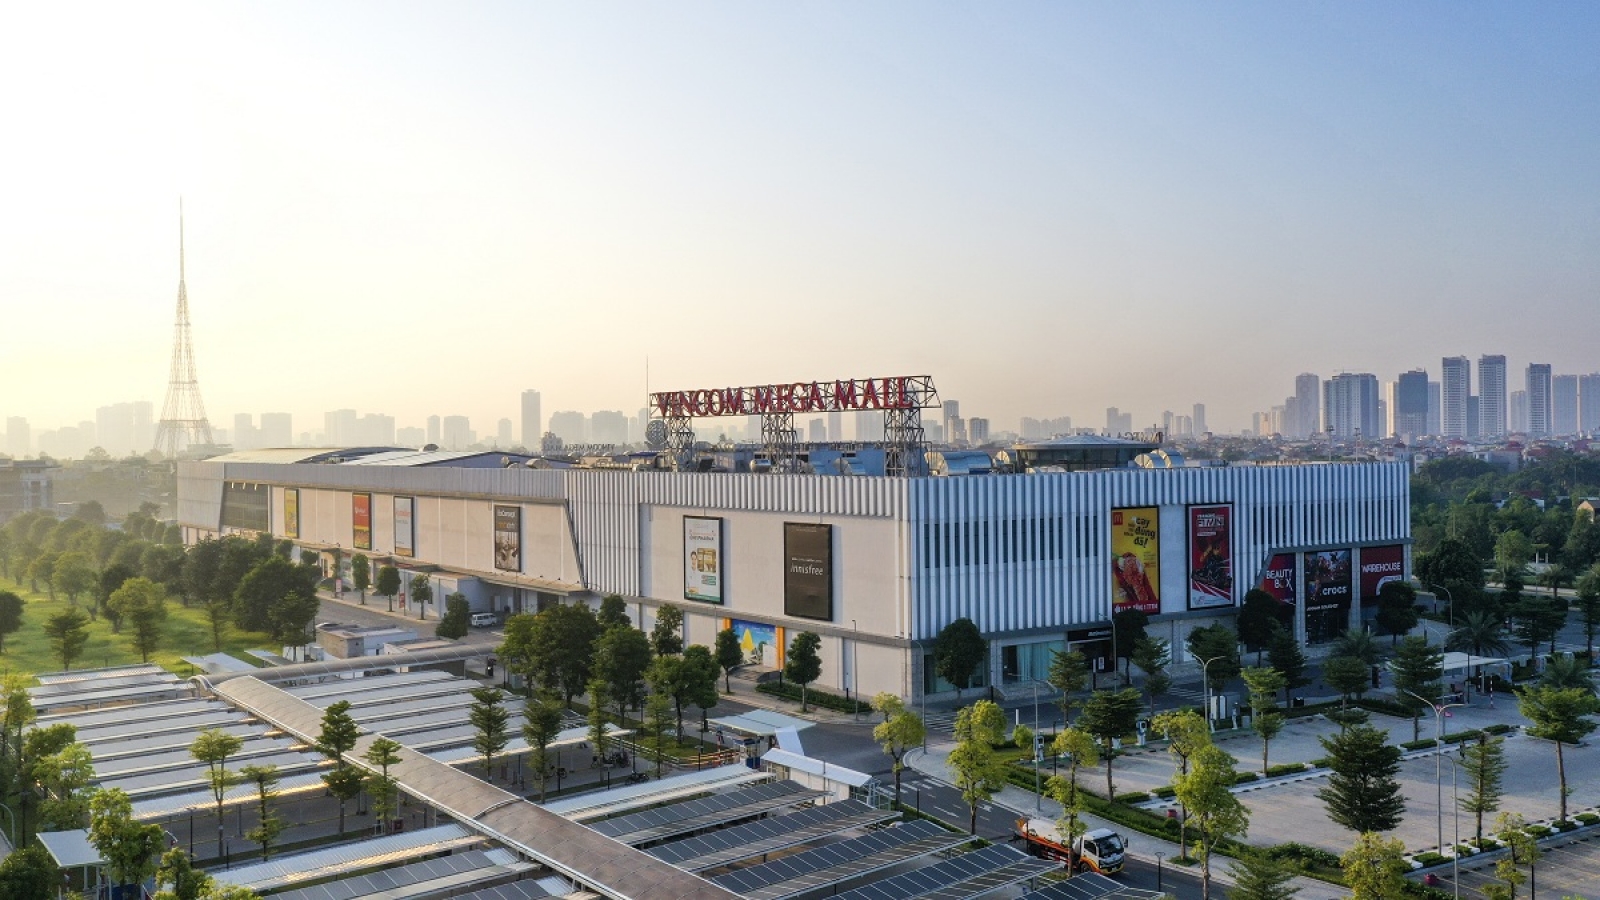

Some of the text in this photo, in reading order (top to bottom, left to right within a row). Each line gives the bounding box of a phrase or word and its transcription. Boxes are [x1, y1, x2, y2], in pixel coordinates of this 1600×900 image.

[657, 376, 914, 417] VINCOM MEGA MALL
[1135, 518, 1150, 528] cay
[790, 562, 824, 576] innisfree
[1361, 562, 1401, 573] WAREHOUSE
[1266, 568, 1293, 580] BEAUTY
[1322, 586, 1348, 596] crocs
